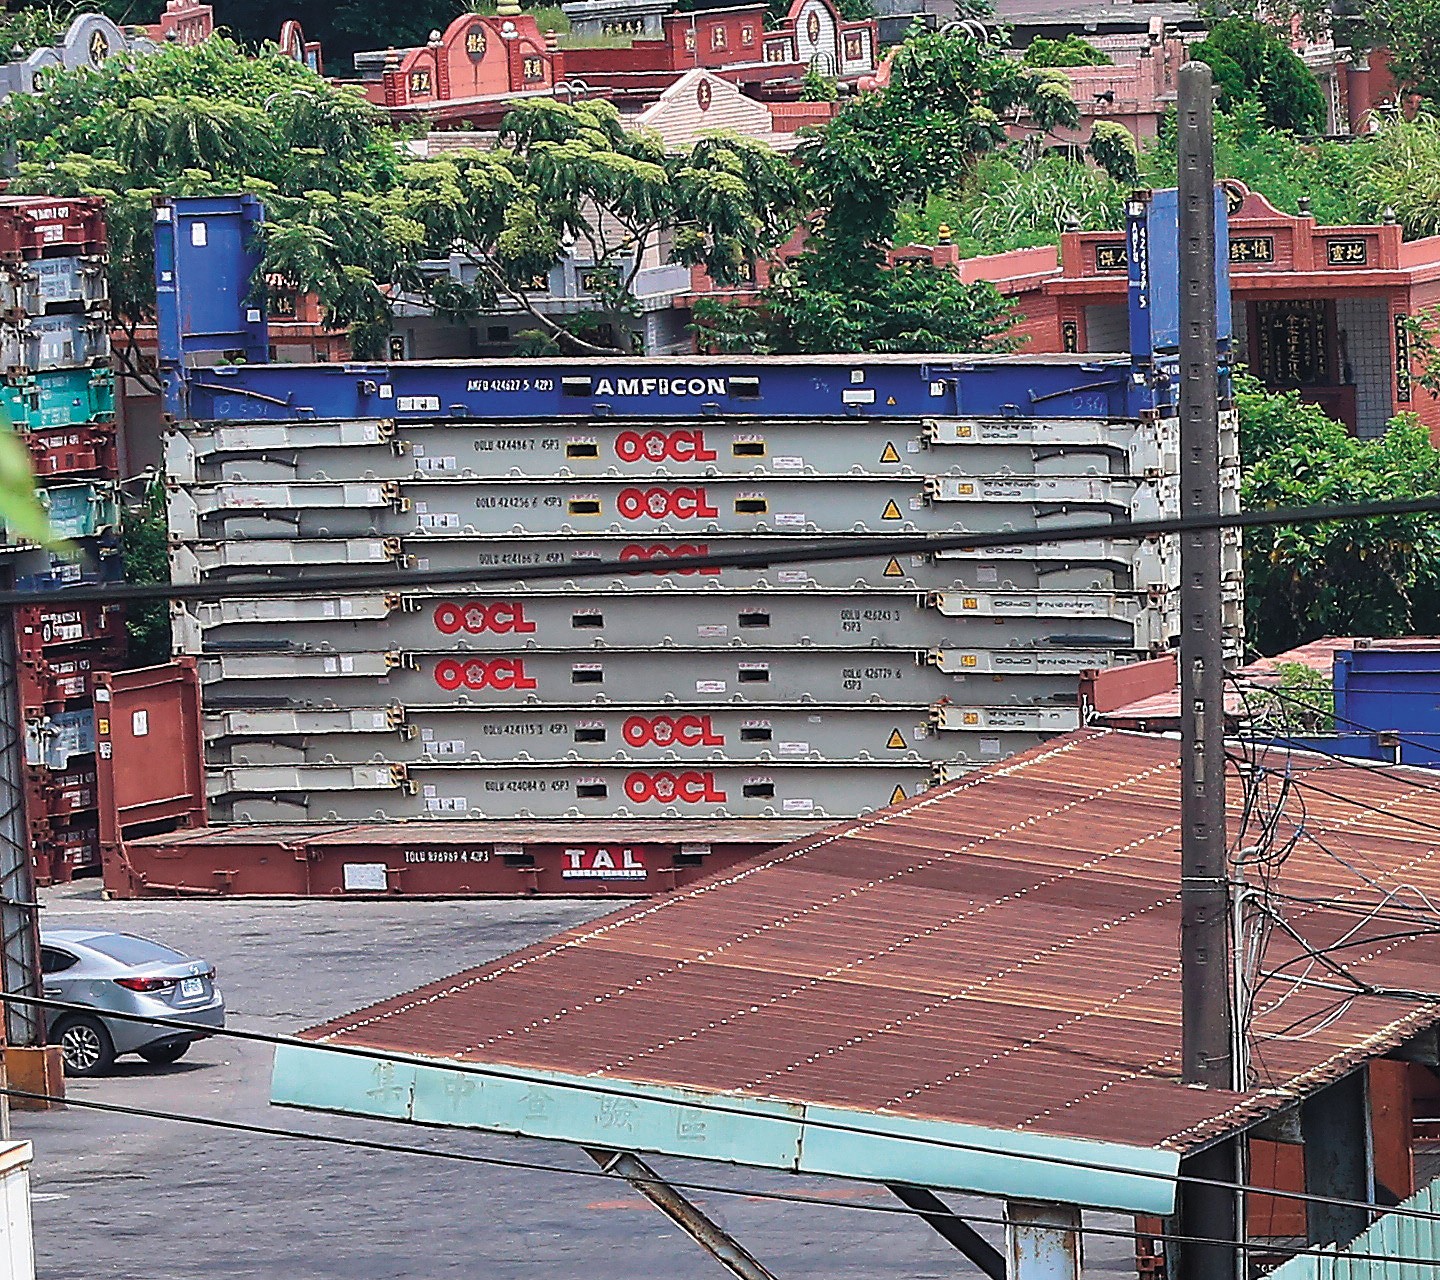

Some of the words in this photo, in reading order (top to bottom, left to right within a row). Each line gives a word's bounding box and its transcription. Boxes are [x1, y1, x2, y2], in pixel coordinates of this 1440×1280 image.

[614, 430, 717, 462] OOCL
[617, 488, 718, 519] OOCL
[433, 603, 536, 634] OOCL
[433, 659, 537, 690] OOCL
[622, 715, 725, 747] OOCL
[624, 772, 726, 803] OOCL
[565, 850, 644, 869] TAL
